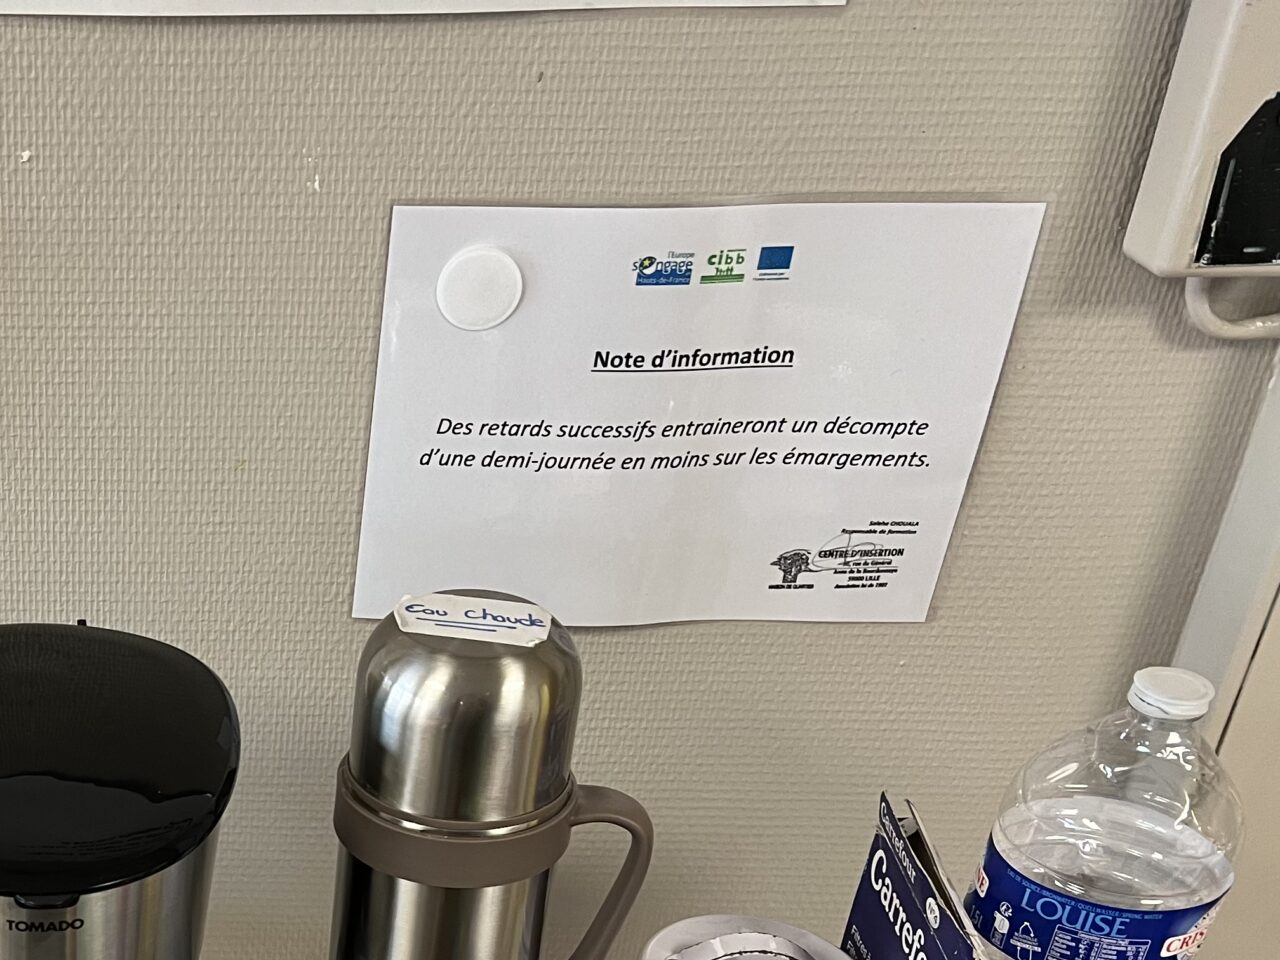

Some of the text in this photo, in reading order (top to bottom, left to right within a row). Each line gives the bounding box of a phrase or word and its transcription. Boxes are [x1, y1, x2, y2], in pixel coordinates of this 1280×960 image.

[708, 250, 745, 265] cibb
[593, 351, 645, 369] Note
[436, 416, 929, 442] Des retards successifs entraineront un décompte
[481, 450, 615, 472] demi-journée
[620, 456, 644, 470] en
[650, 451, 710, 469] moins
[713, 451, 746, 466] sur
[749, 447, 777, 465] les
[782, 447, 930, 470] émargements.
[880, 802, 916, 884] Carrefour
[6, 918, 84, 932] TOMADO
[1021, 888, 1130, 938] LOUISE
